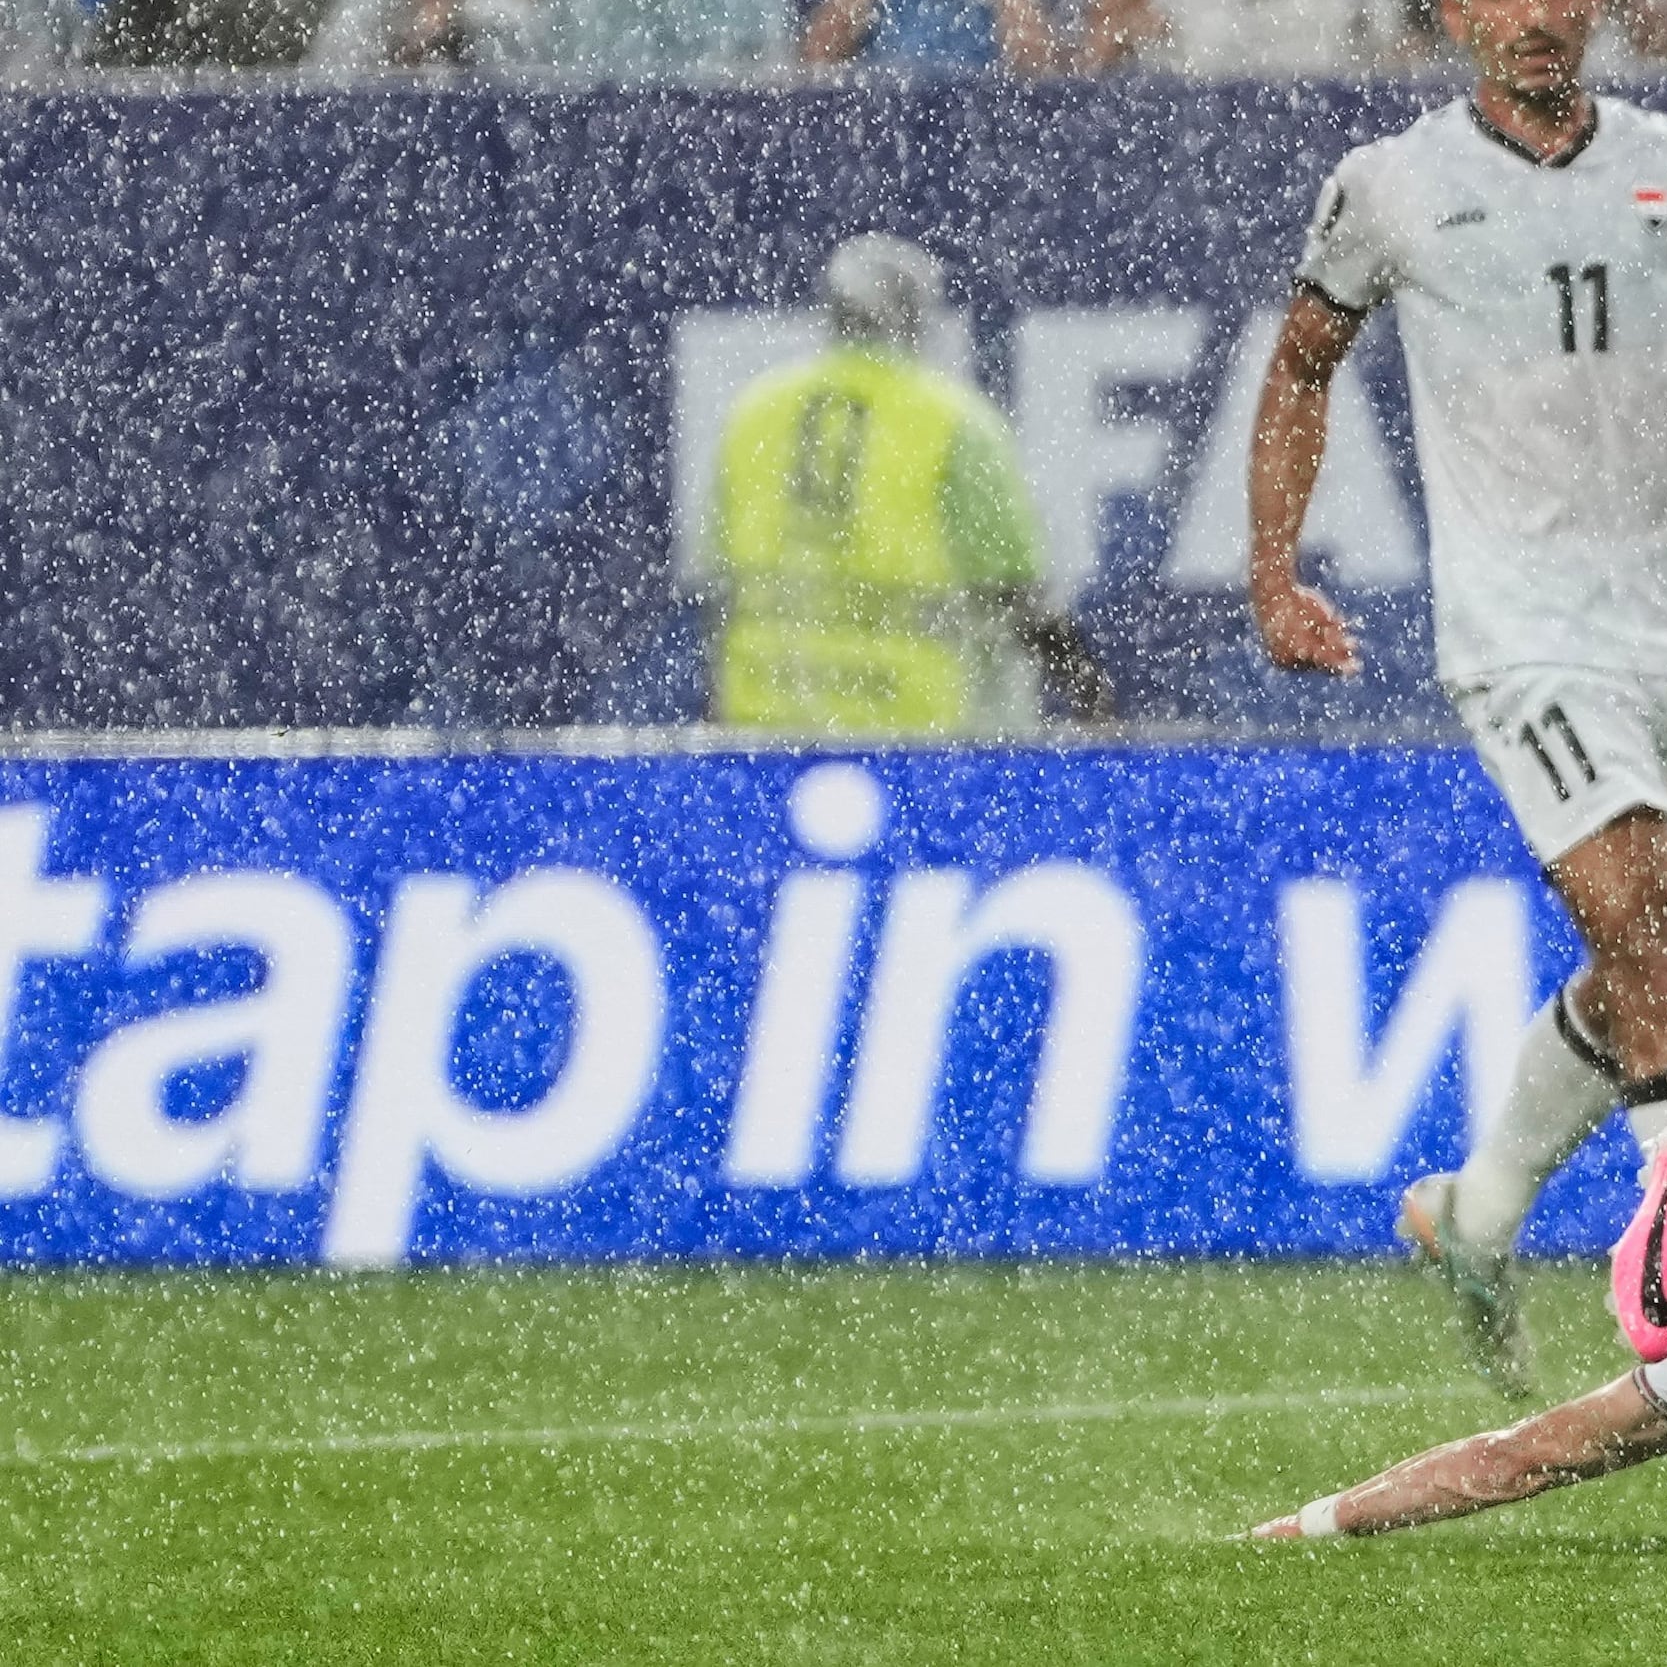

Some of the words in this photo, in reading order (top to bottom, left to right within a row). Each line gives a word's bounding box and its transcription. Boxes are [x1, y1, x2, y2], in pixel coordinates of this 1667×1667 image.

[1545, 261, 1608, 354] 11
[672, 309, 1428, 592] FFA
[1517, 701, 1596, 801] 11
[726, 763, 1143, 1185] in
